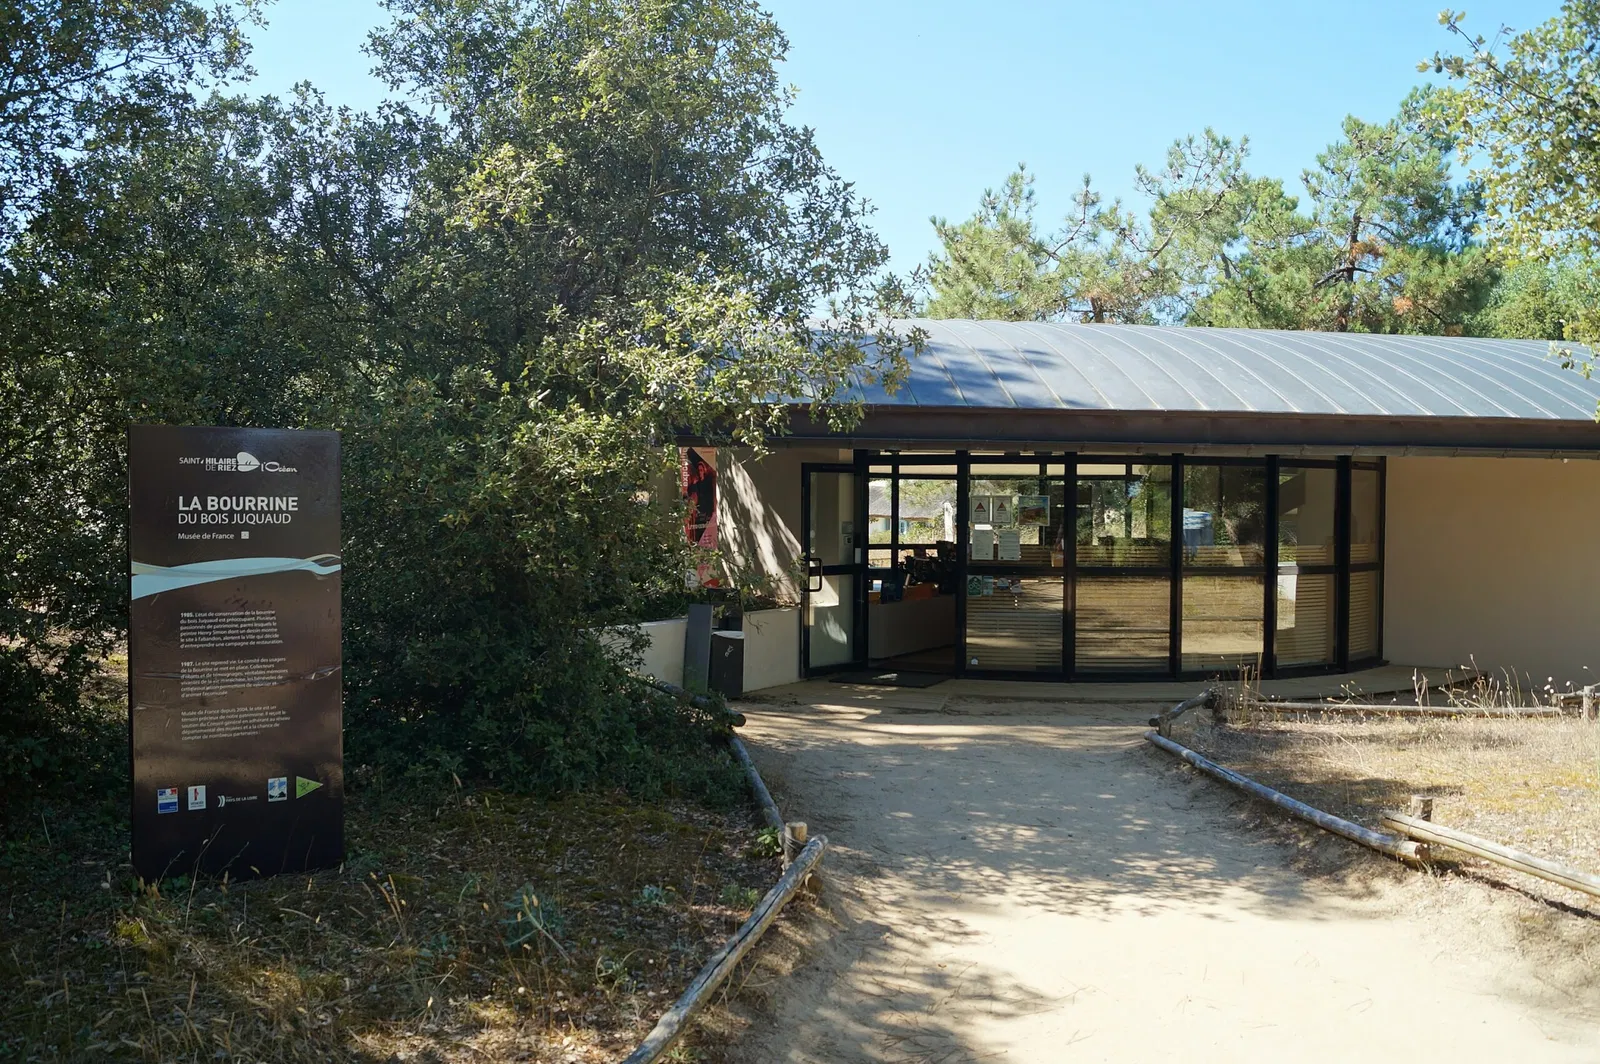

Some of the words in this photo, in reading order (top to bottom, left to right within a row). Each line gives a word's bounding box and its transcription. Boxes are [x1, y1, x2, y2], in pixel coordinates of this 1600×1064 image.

[178, 496, 202, 511] LA
[207, 496, 298, 511] BOURRINE
[178, 513, 197, 524] DU
[200, 513, 229, 524] BOIS
[232, 513, 292, 525] JUQUAUD
